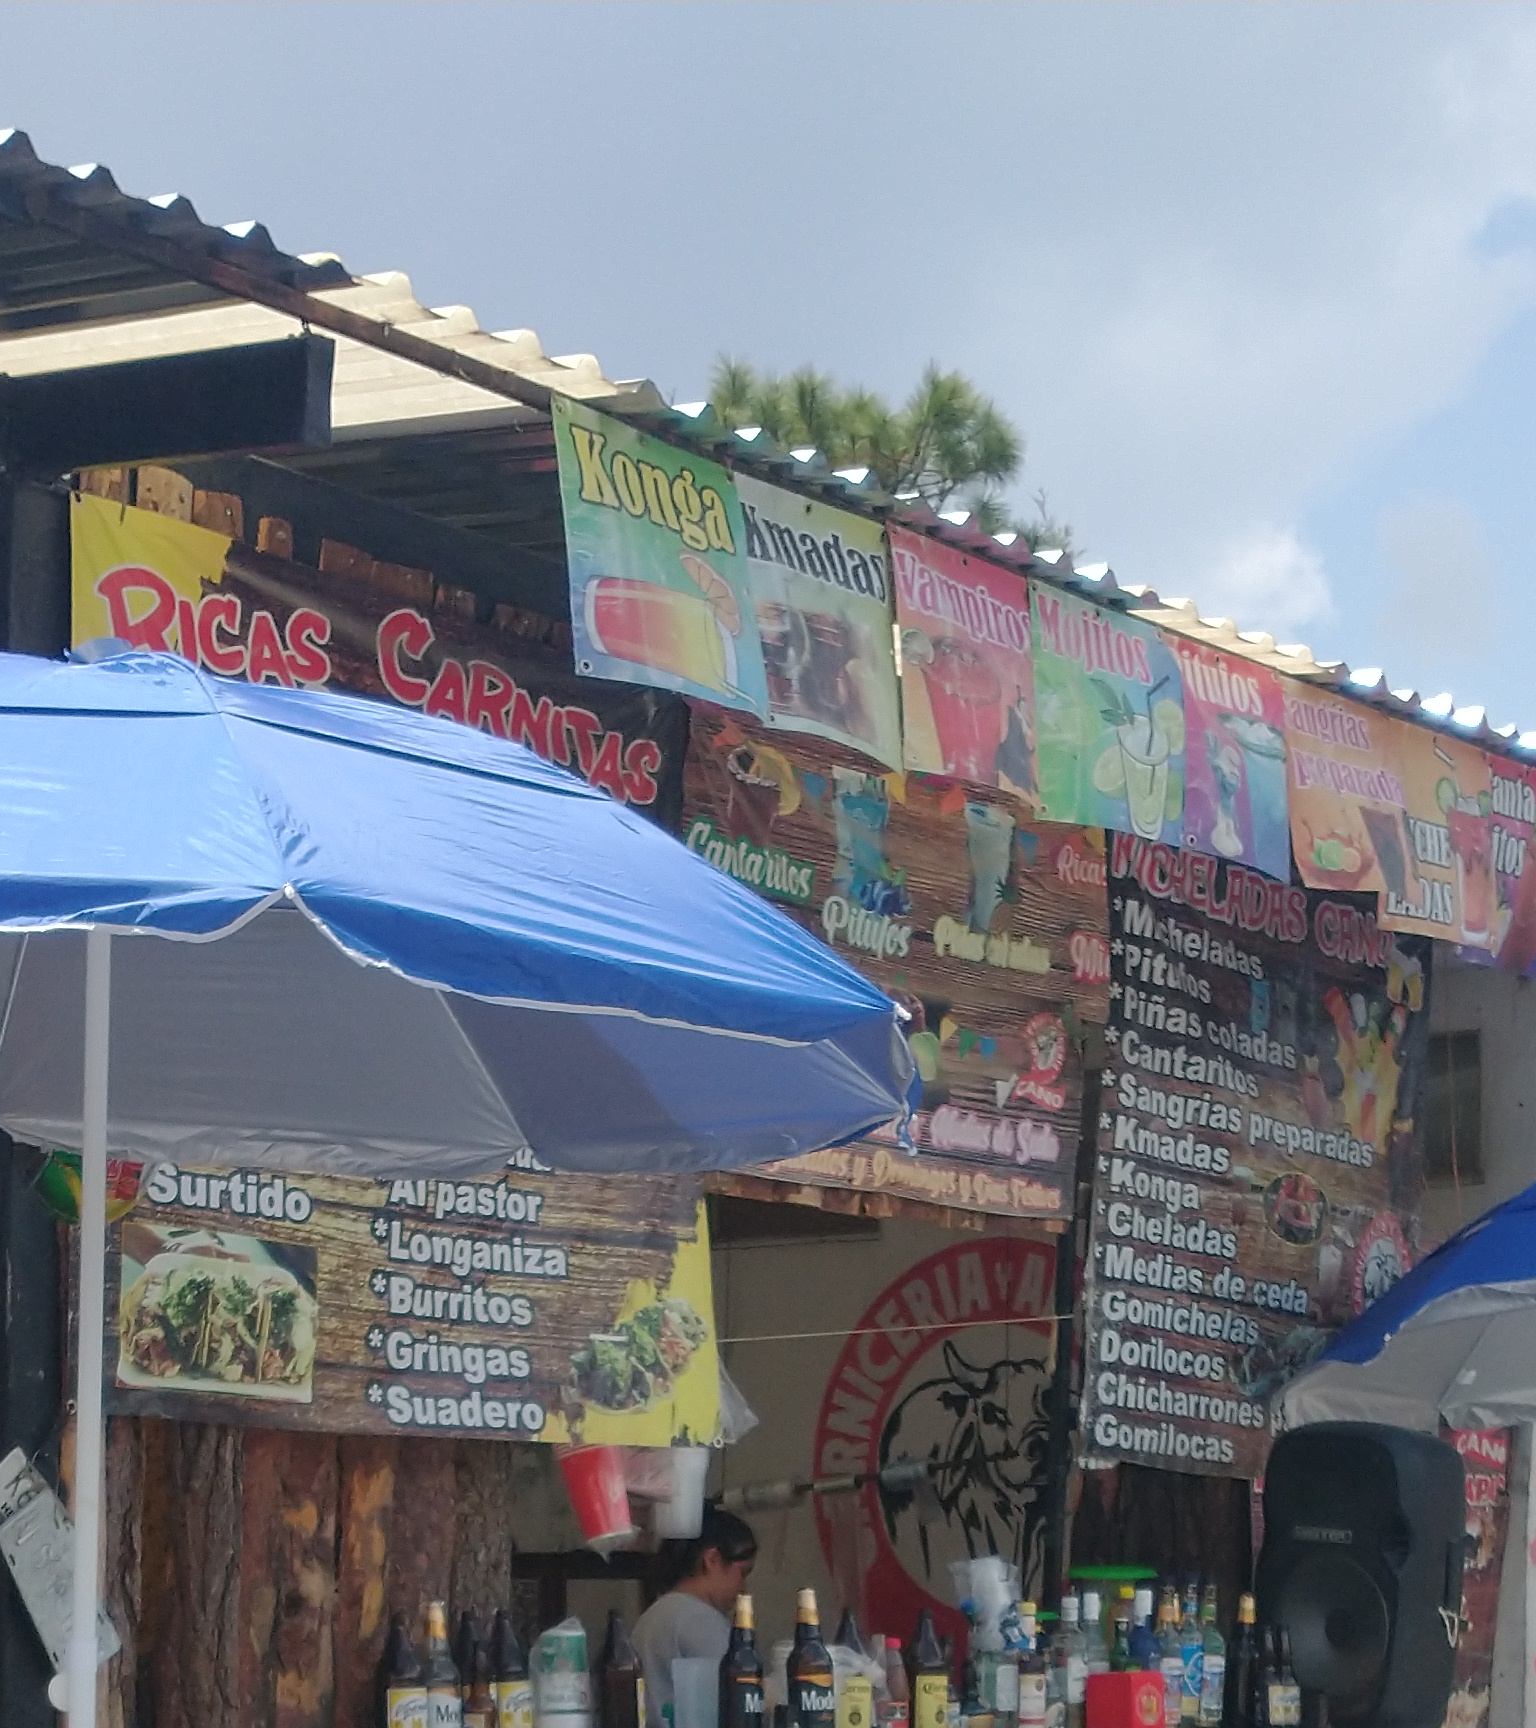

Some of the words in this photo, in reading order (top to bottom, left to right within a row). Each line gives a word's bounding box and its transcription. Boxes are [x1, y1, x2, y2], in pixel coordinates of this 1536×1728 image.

[571, 425, 737, 555] Konga
[1036, 592, 1153, 686] Mojitos
[97, 564, 332, 688] RICAS
[378, 608, 662, 805] CARNITAS
[1176, 648, 1264, 718] itufos
[1290, 697, 1372, 750] angrias
[1292, 749, 1407, 810] preparada
[1491, 774, 1536, 825] anta
[1408, 816, 1452, 869] CHE
[1491, 824, 1528, 879] itos
[1113, 832, 1308, 944] MICHELADAS
[1123, 985, 1204, 1040] Piñas
[1206, 1019, 1298, 1071] coladas
[1121, 1029, 1261, 1099] Cantaritos
[1113, 1114, 1231, 1175] Kmadas
[1117, 1072, 1244, 1134] Sangrias
[1248, 1111, 1376, 1169] preparadas
[146, 1161, 313, 1223] Surtido
[435, 1175, 542, 1224] pastor
[1109, 1157, 1201, 1214] Konga
[387, 1219, 567, 1278] Longaniza
[1106, 1201, 1239, 1260] Cheladas
[387, 1274, 533, 1327] Burritos
[1102, 1243, 1206, 1296] Medias
[1212, 1264, 1247, 1302] de
[1101, 1289, 1261, 1348] Gomichelas
[385, 1328, 531, 1380] Gringas
[821, 1250, 993, 1487] RNICERIA
[1099, 1328, 1227, 1383] Dorilocos
[386, 1384, 545, 1433] Suadero
[1096, 1370, 1265, 1430] Chicharrones
[1093, 1412, 1236, 1466] Gomilocas
